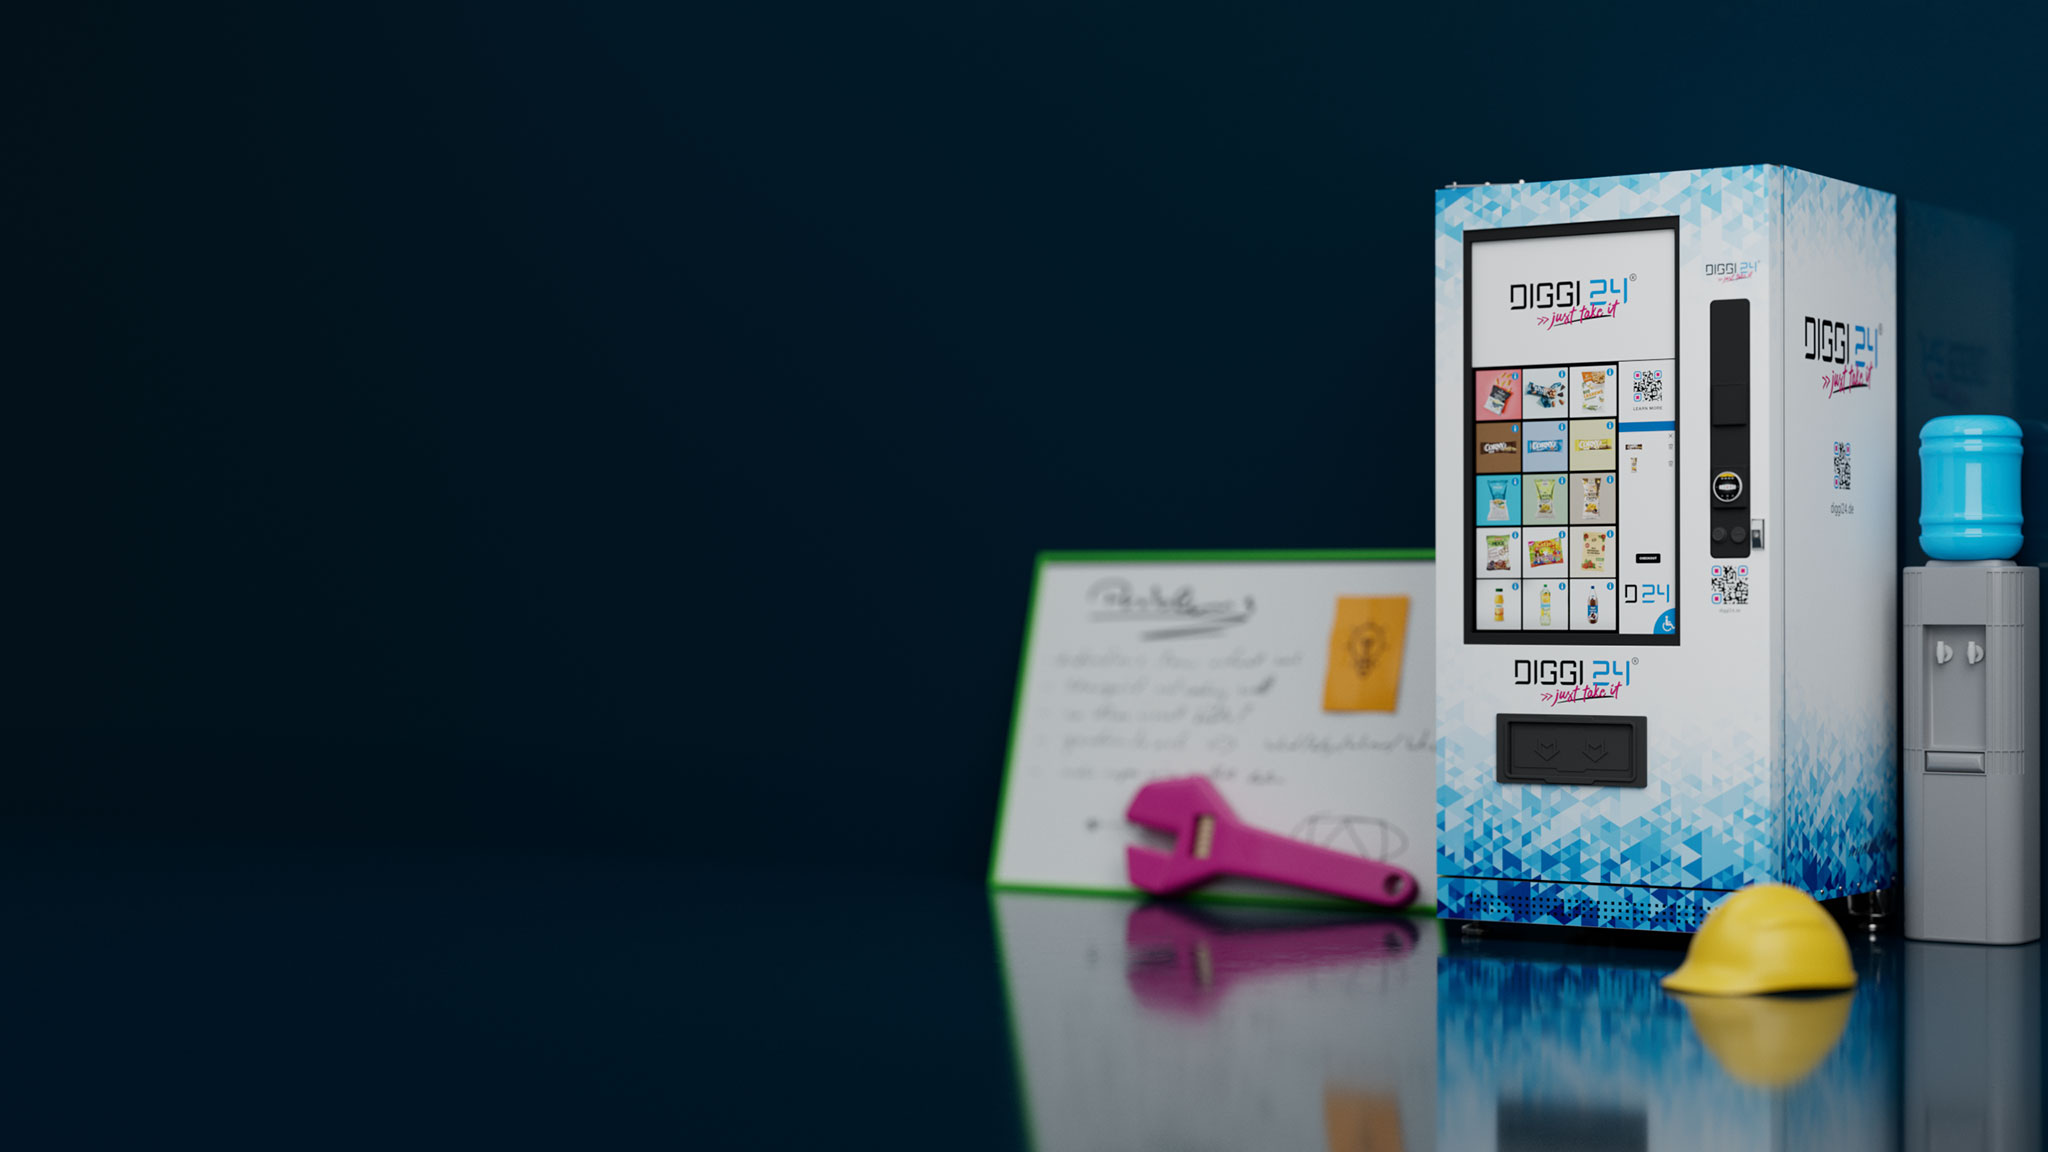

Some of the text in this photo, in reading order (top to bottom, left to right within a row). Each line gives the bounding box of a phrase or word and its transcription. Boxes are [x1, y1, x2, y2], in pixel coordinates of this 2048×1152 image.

[1705, 263, 1737, 275] DIGGI
[1510, 277, 1628, 310] DIGGI 24
[1546, 299, 1620, 331] just take it
[1805, 316, 1878, 368] DIGGI 24
[1828, 364, 1848, 399] just
[1642, 584, 1669, 603] 24
[1514, 659, 1630, 686] DIGGI 24
[1551, 681, 1622, 707] just take it
